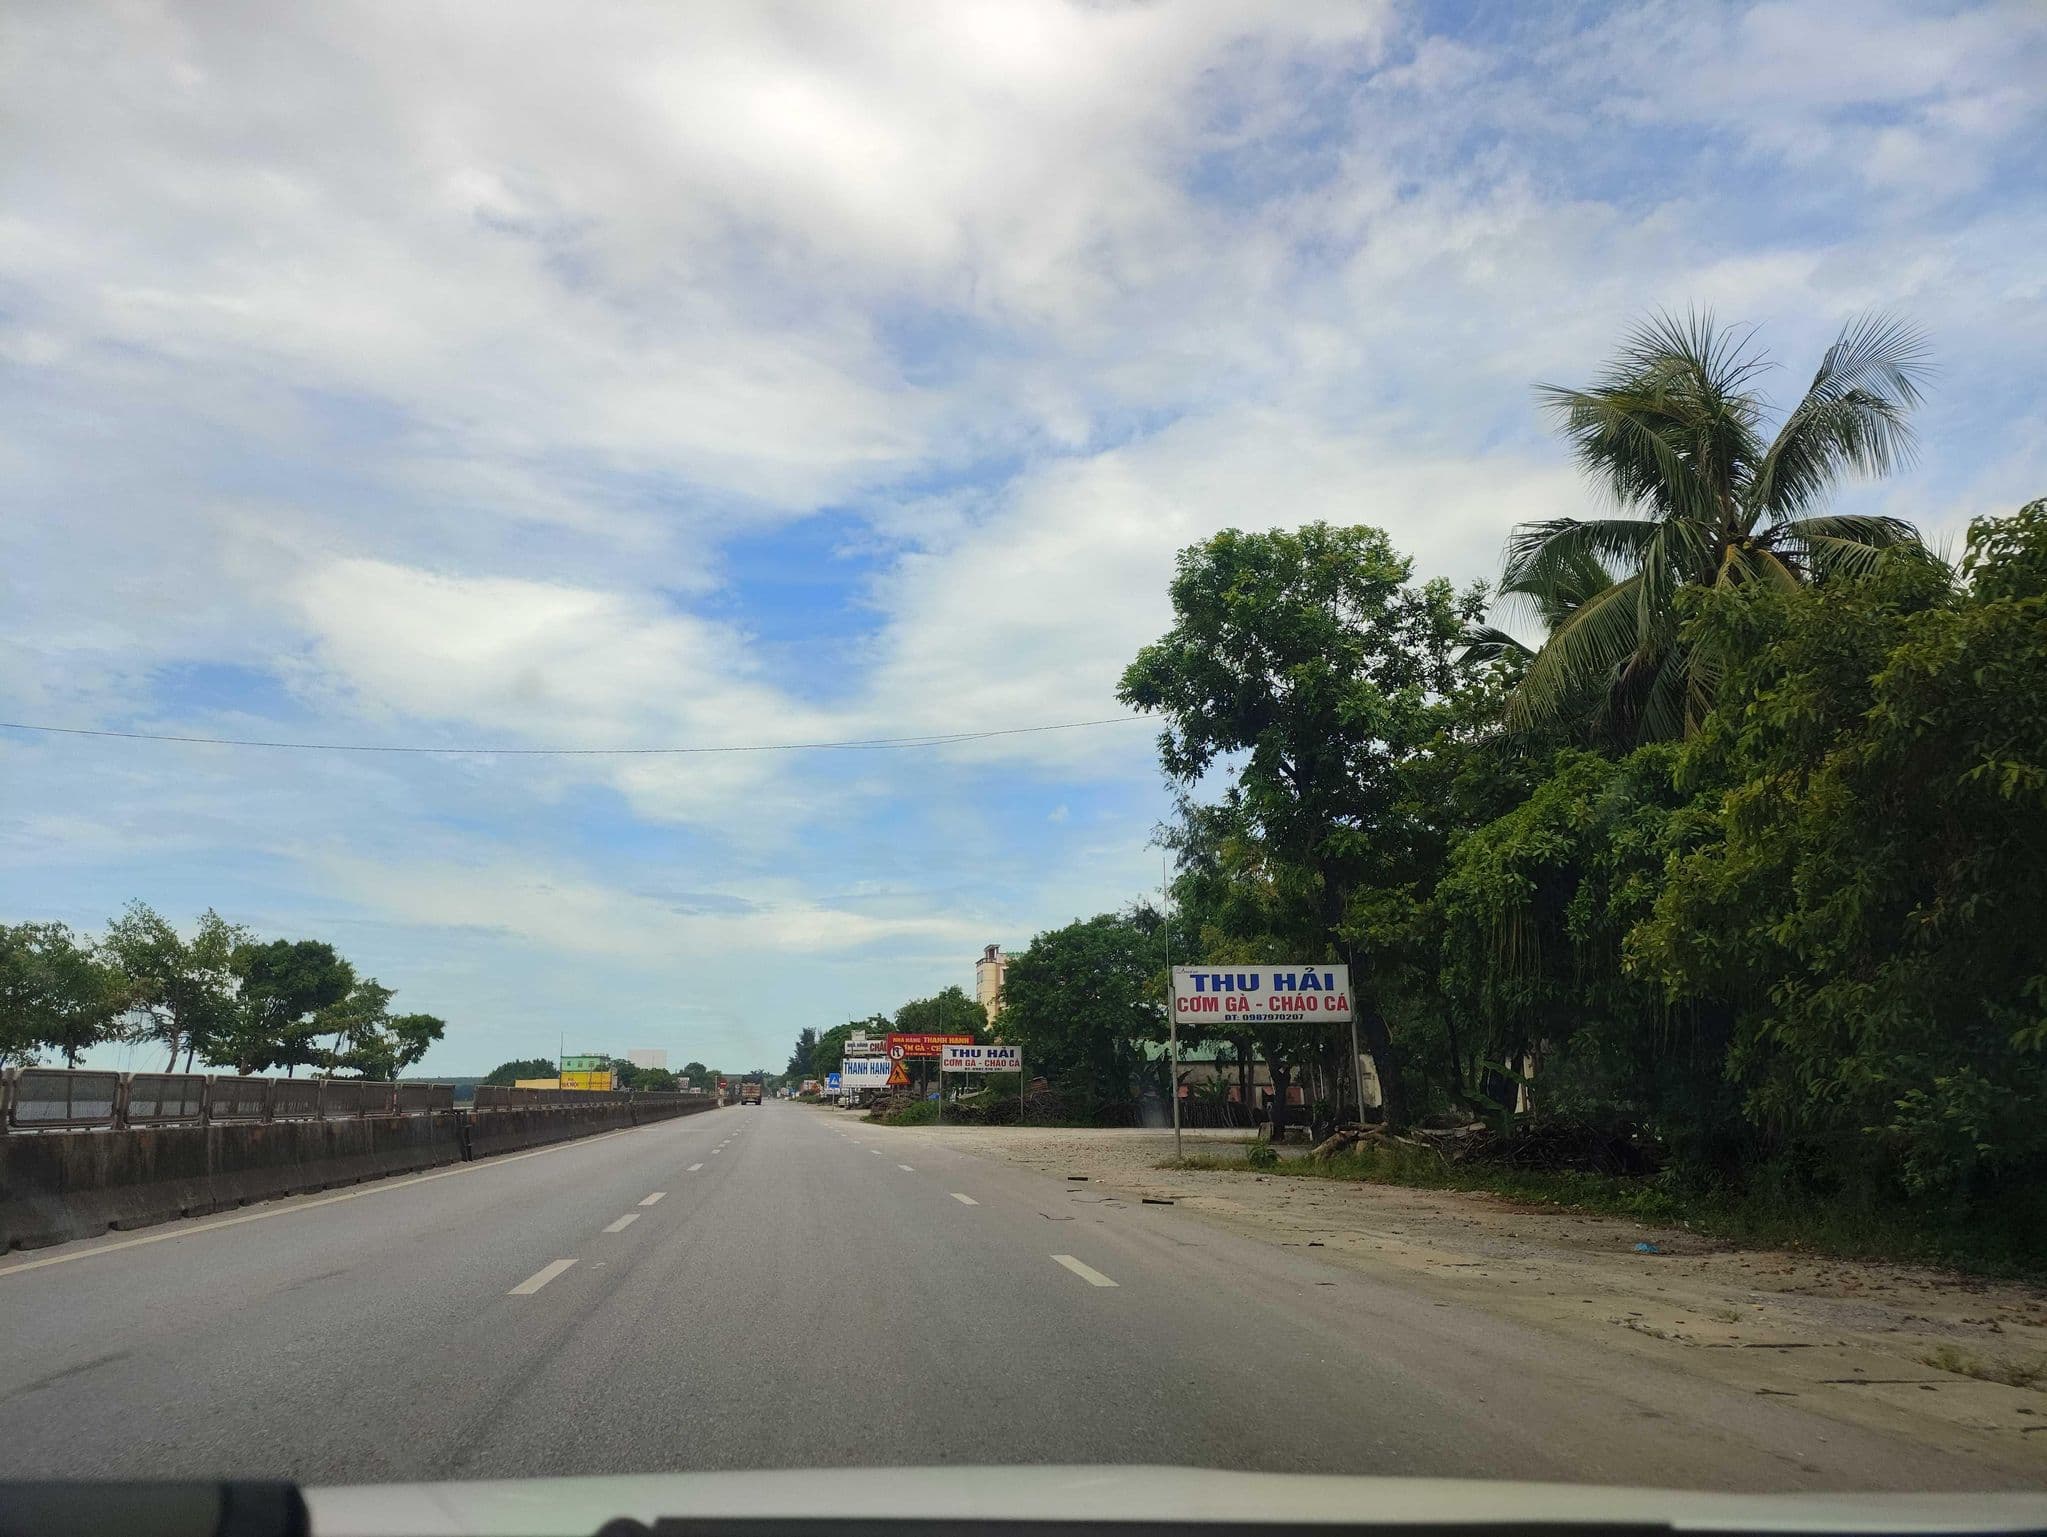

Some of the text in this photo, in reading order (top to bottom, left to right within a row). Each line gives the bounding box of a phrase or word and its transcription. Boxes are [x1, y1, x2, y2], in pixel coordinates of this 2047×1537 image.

[1190, 966, 1334, 993] THU HẢI
[1177, 995, 1219, 1012] CƠM
[1225, 993, 1250, 1012] GÀ
[1269, 993, 1318, 1011] CHÁO
[1324, 993, 1349, 1011] CÁ
[950, 1048, 982, 1058] THU
[987, 1046, 1015, 1058] HẢI
[844, 1061, 868, 1075] THANH
[944, 1058, 963, 1067] CƠM
